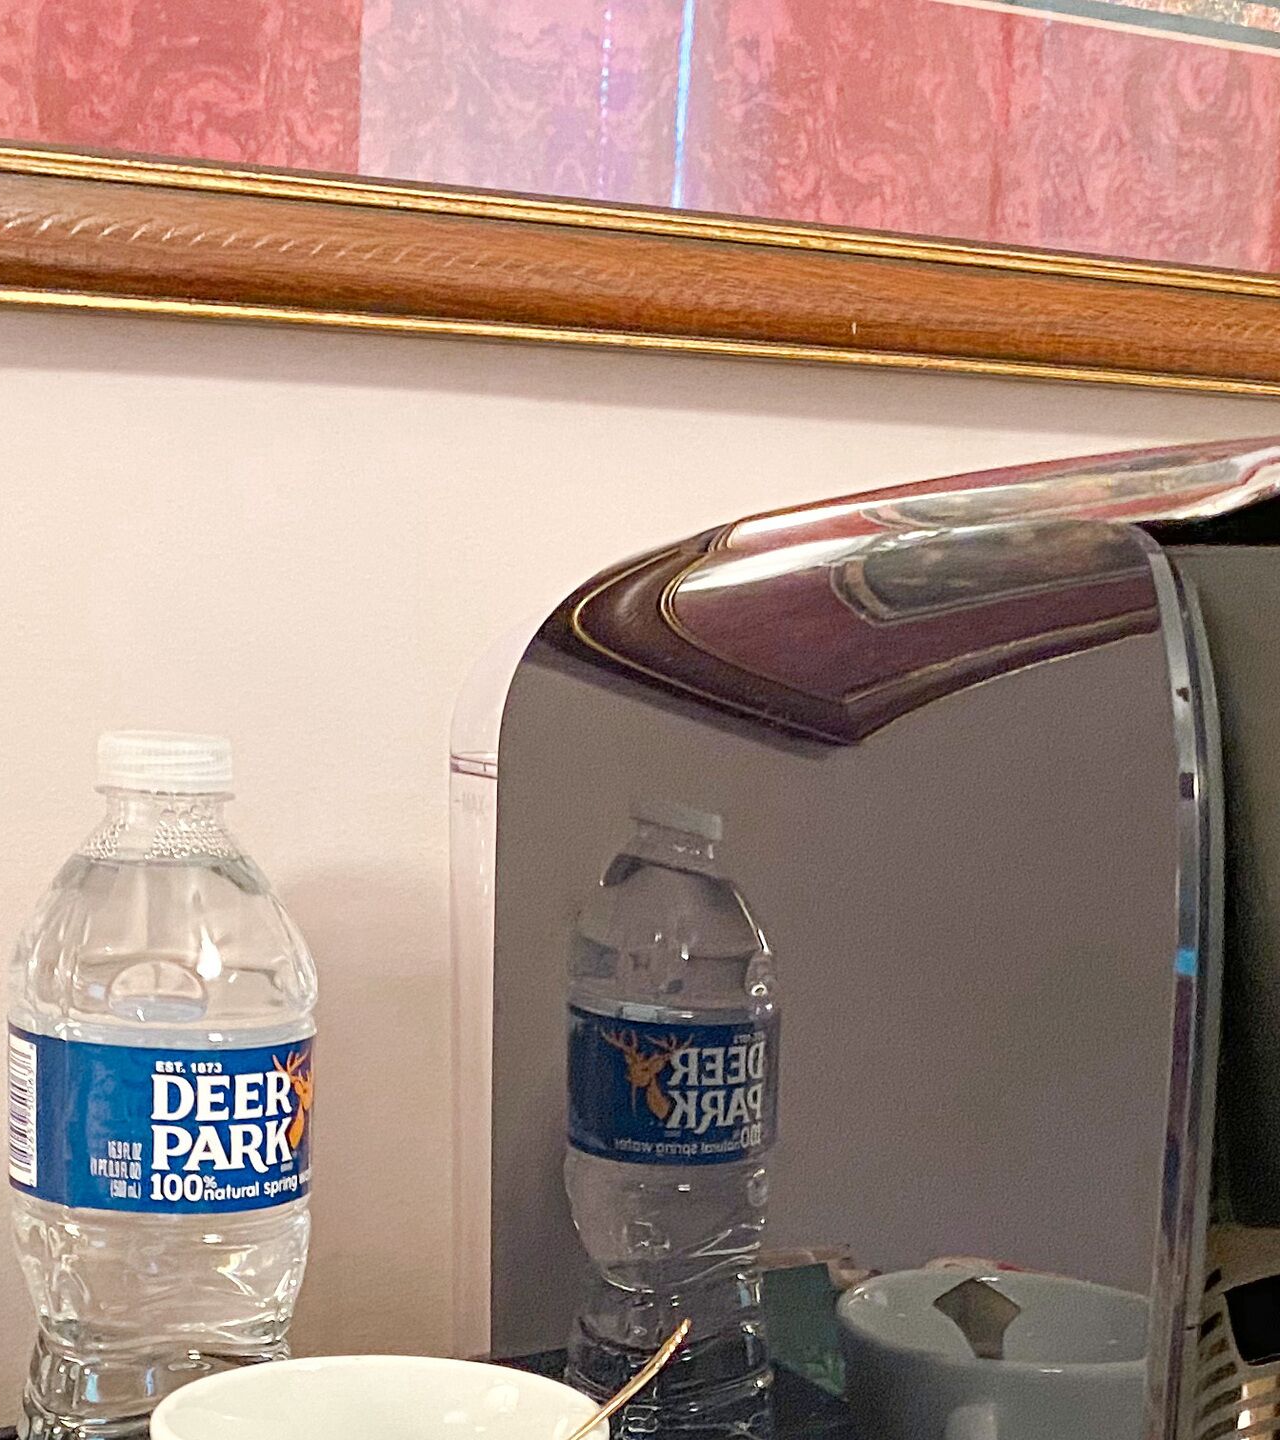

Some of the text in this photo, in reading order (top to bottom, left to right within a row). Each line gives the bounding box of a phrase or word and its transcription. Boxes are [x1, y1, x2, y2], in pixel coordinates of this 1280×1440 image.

[155, 1060, 186, 1073] EST.
[150, 1071, 293, 1121] DEER
[150, 1116, 293, 1174] PARK
[204, 1181, 260, 1201] natural
[263, 1174, 298, 1198] spring
